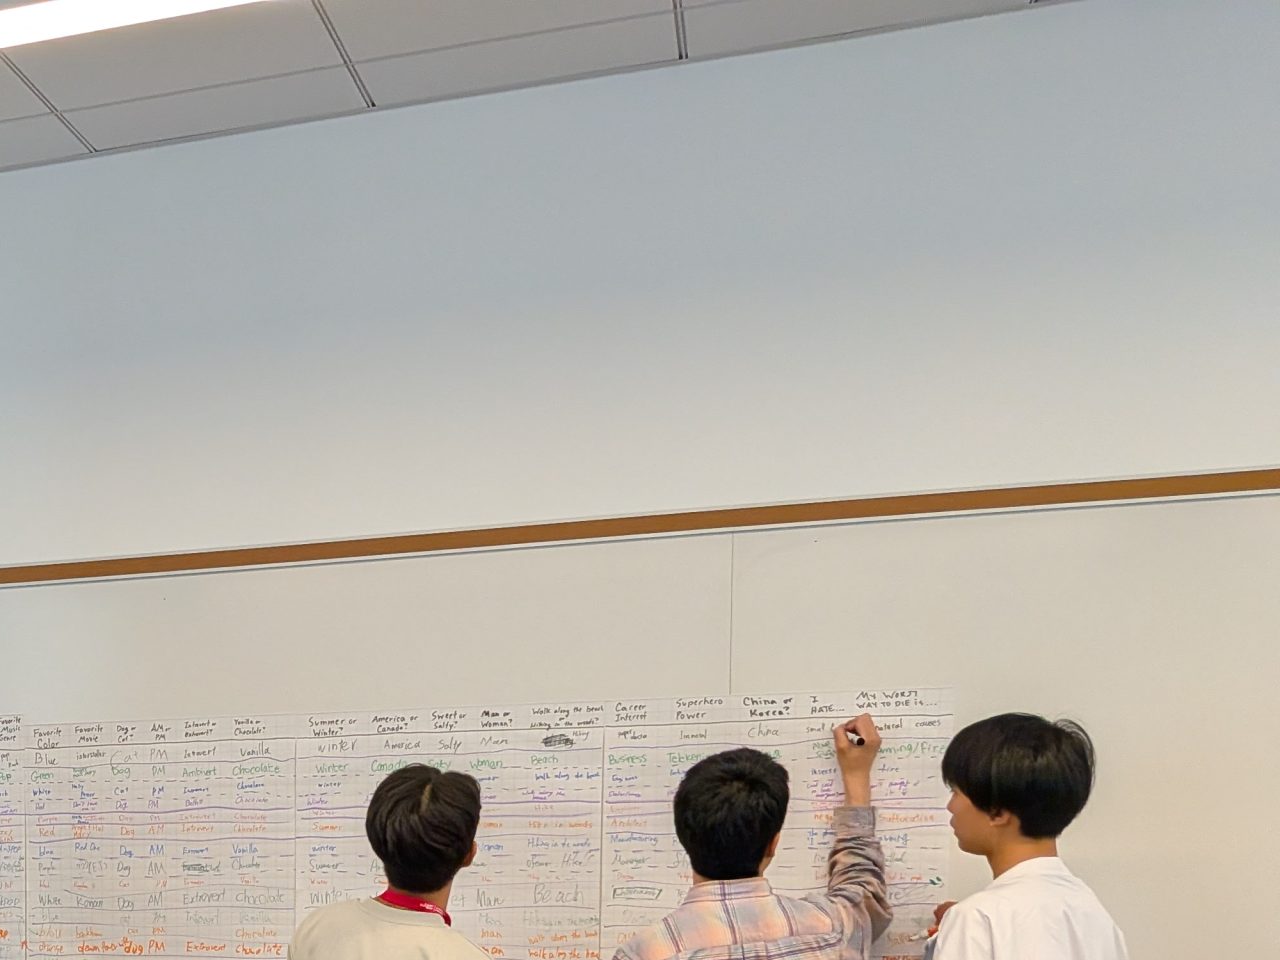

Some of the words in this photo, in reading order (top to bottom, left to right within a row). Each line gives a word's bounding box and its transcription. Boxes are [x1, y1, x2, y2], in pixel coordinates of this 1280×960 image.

[675, 697, 724, 709] Superhero
[743, 696, 777, 707] China
[810, 695, 818, 703] I
[856, 700, 877, 709] WAY
[894, 699, 909, 707] DIE
[532, 707, 552, 715] Walk
[553, 706, 570, 717] along
[614, 702, 647, 712] Career
[749, 706, 790, 717] Korea?
[371, 715, 406, 723] America
[431, 711, 456, 720] Sweet
[481, 709, 500, 718] Man
[615, 712, 648, 722] Interest
[675, 711, 707, 720] Power
[308, 716, 345, 727] Summer
[433, 720, 458, 731] Salty?
[481, 718, 513, 728] Woman?
[0, 724, 20, 734] Music
[33, 726, 62, 738] Favorite
[74, 723, 103, 734] Favorite
[116, 725, 128, 734] Dog
[151, 723, 164, 732] AM
[312, 727, 344, 737] Winter?
[377, 723, 408, 733] Canada?
[747, 722, 780, 737] China
[0, 733, 17, 743] Genre
[78, 735, 98, 743] Movie
[155, 733, 166, 741] PM
[480, 735, 508, 746] Man
[37, 738, 60, 749] Color
[240, 741, 272, 757] Vanilla
[383, 739, 421, 750] America
[438, 737, 462, 754] Salty
[35, 752, 59, 765] Blue
[150, 748, 169, 761] PM
[530, 755, 559, 765] Beach
[232, 763, 281, 776] Chocolate
[315, 763, 349, 774] Winter
[469, 759, 504, 770] Woman
[30, 768, 54, 783] Green
[39, 827, 55, 837] Red
[120, 827, 134, 838] Dog
[149, 844, 165, 855] AM
[117, 861, 131, 876] Dog
[148, 861, 167, 875] AM
[183, 889, 226, 905] Extrovert
[533, 883, 584, 904] Beach
[148, 939, 166, 952] PM
